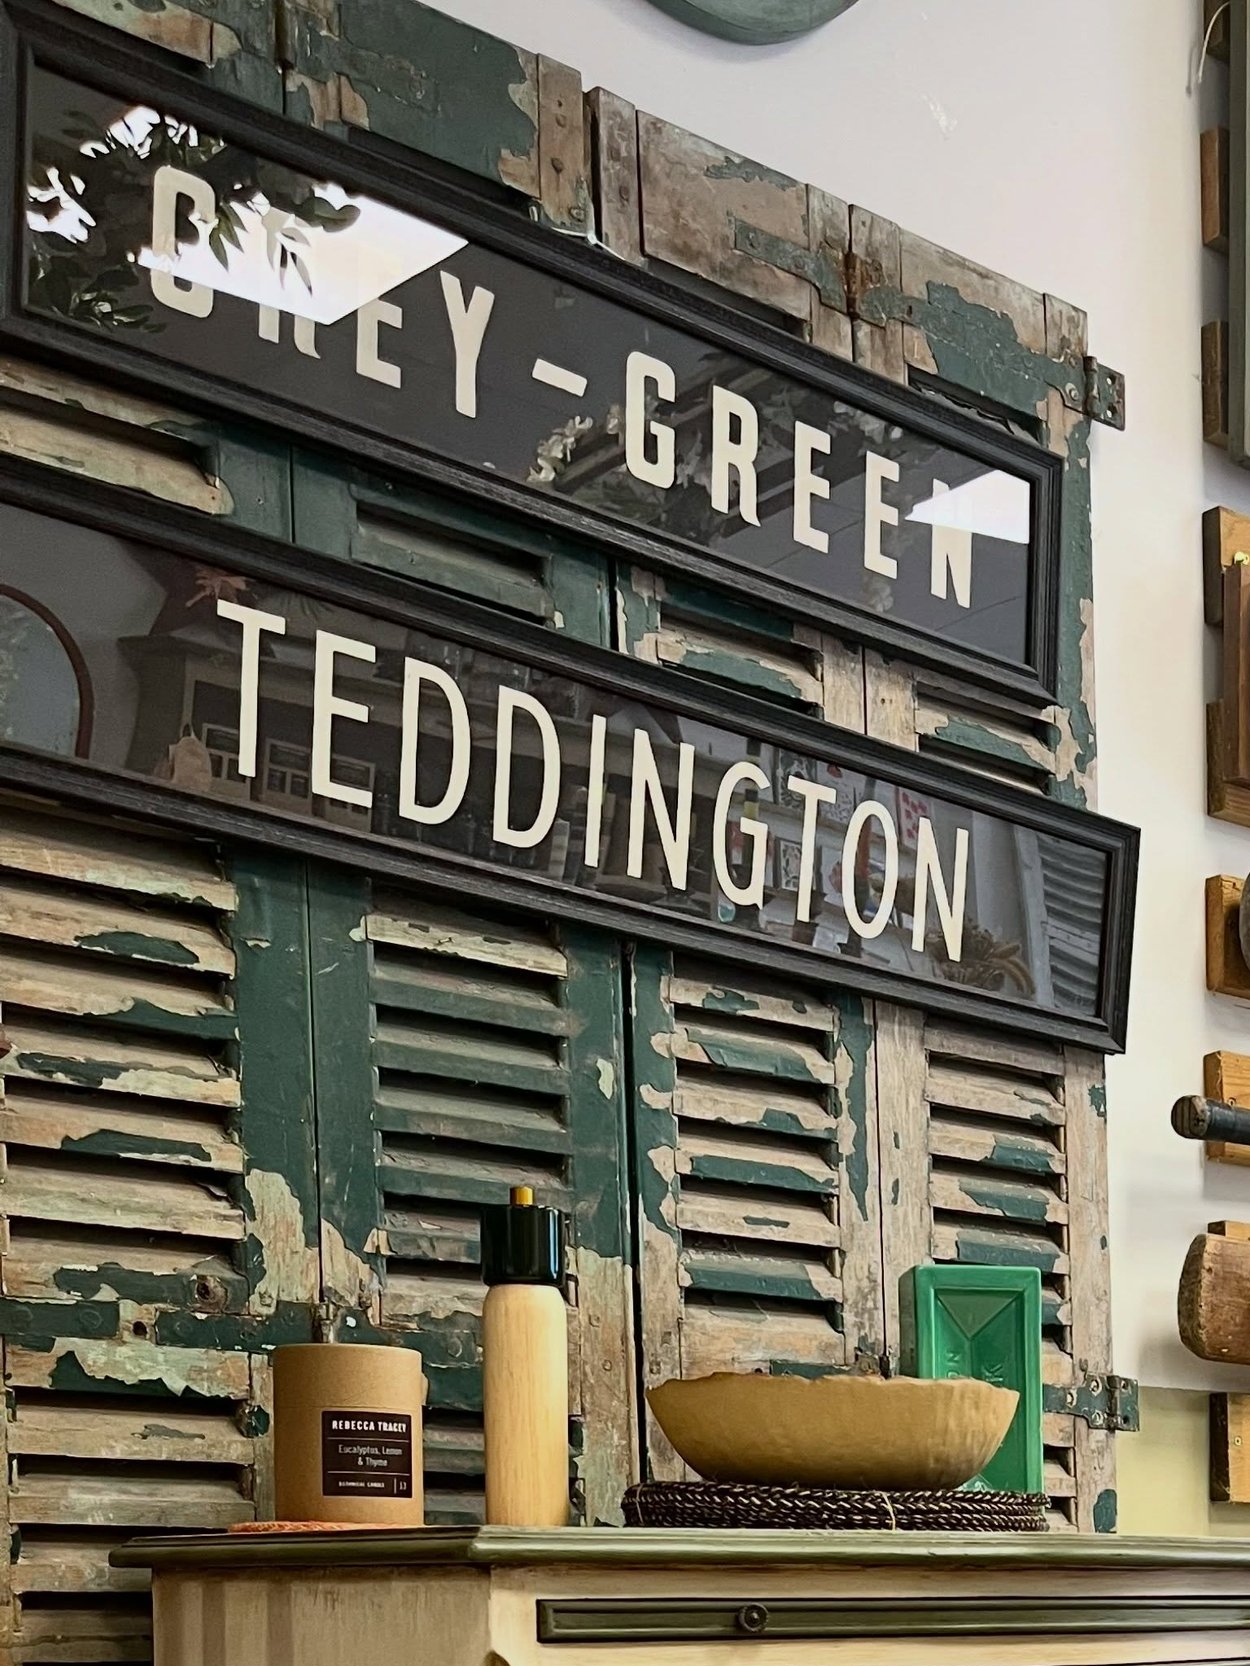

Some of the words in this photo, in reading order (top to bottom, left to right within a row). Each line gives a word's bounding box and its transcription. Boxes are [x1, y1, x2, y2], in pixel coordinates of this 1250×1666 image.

[216, 600, 970, 962] TEDDINGTON
[332, 1420, 375, 1431] REBECCA
[338, 1444, 380, 1455] Eucalyptus,
[358, 1457, 363, 1466] &
[365, 1457, 388, 1467] Thyme
